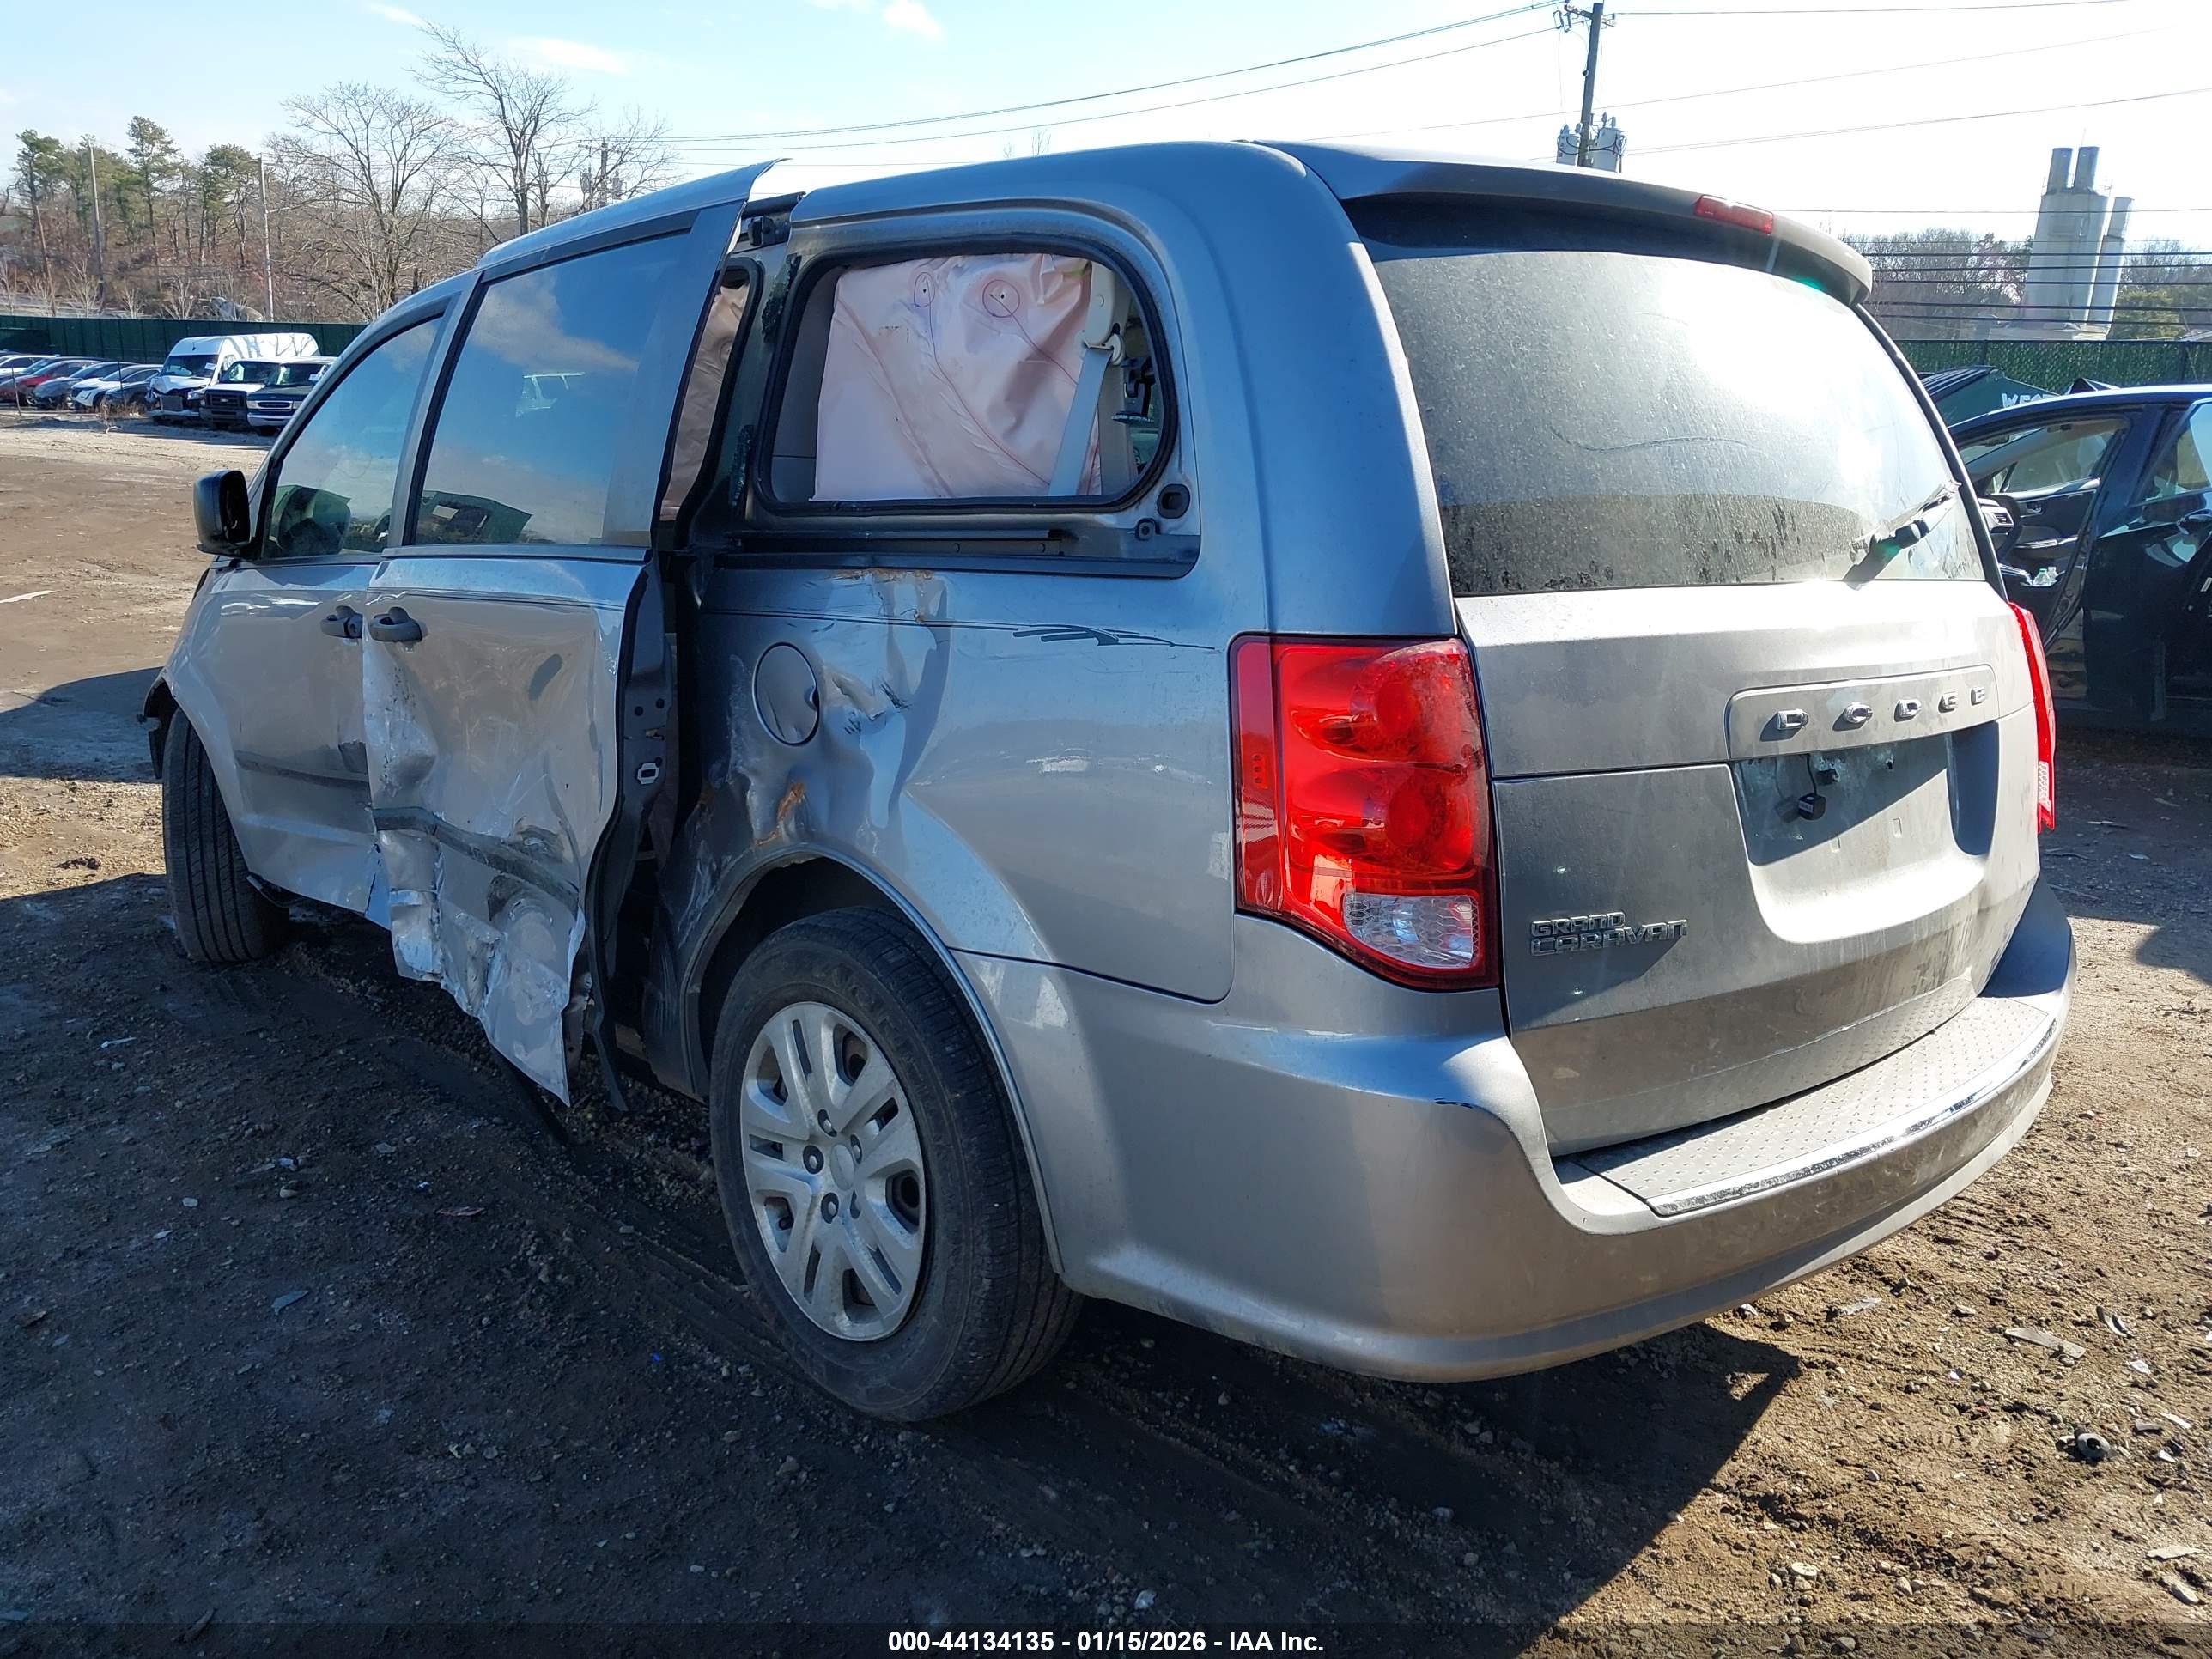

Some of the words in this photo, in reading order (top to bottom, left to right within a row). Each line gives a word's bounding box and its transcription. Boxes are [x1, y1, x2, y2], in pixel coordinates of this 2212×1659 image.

[1777, 687, 1986, 730] DODGE
[1531, 912, 1626, 937] GRAND
[1531, 919, 1688, 956] CARAVAN
